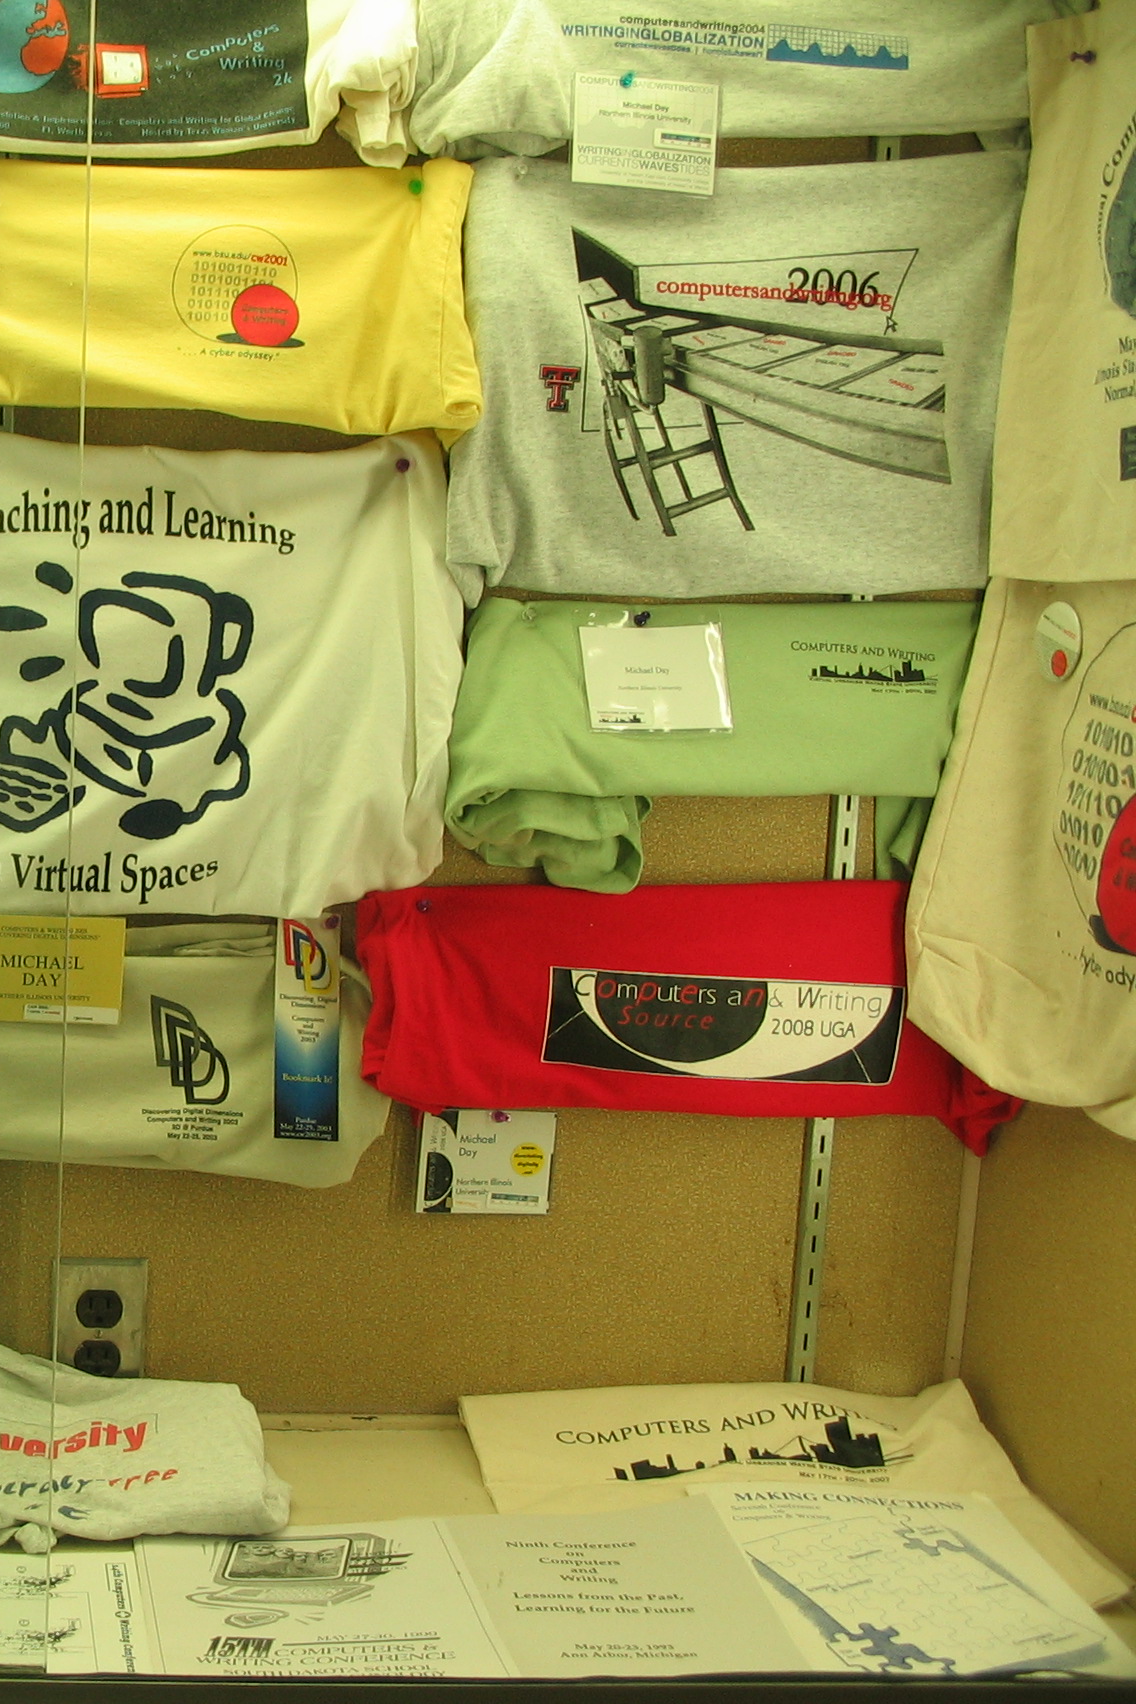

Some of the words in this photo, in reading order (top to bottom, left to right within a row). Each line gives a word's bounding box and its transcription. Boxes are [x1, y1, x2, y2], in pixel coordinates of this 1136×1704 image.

[620, 15, 766, 35] computersandwriting2004
[186, 24, 281, 60] Computers
[561, 24, 764, 49] WRITINGINGLOBALIZATION
[252, 42, 264, 53] &
[220, 55, 285, 70] Writing
[273, 72, 292, 87] 2k
[623, 102, 653, 111] Michael
[655, 103, 669, 113] Day
[785, 266, 881, 309] 2006
[99, 486, 155, 535] and
[164, 489, 297, 556] Learning
[791, 640, 858, 654] COMPUTERS
[861, 646, 885, 657] AND
[887, 648, 936, 662] WRITING
[624, 666, 654, 674] Michael
[655, 667, 670, 675] Day
[11, 852, 112, 894] Virtual
[120, 853, 219, 905] Spaces
[0, 954, 84, 970] MICHAEL
[22, 973, 62, 987] DAY
[279, 993, 314, 1003] Discovering
[317, 995, 338, 1003] Digital
[574, 973, 716, 1007] Computers
[797, 985, 883, 1018] Writing
[291, 1001, 326, 1009] Dimensions
[617, 1006, 715, 1030] Source
[297, 1029, 320, 1037] Writing
[771, 1018, 814, 1038] 2008
[819, 1021, 857, 1039] UGA
[282, 1073, 322, 1083] Bookmark
[205, 1109, 244, 1117] Dimensions
[295, 1116, 317, 1124] Purdue
[280, 1123, 294, 1131] May
[167, 1132, 181, 1140] May
[459, 1133, 497, 1144] Michael
[459, 1147, 478, 1159] Day
[456, 1178, 488, 1186] Northern
[556, 1418, 712, 1445] COMPUTERS
[720, 1409, 776, 1432] AND
[733, 1491, 818, 1501] MAKING
[822, 1493, 965, 1511] CONNECTIONS
[505, 1541, 549, 1549] Ninth
[553, 1540, 637, 1550] Conference
[538, 1557, 621, 1567] Computers
[559, 1574, 618, 1584] Writing
[513, 1591, 574, 1600] Lessons
[578, 1592, 615, 1601] from
[619, 1593, 643, 1601] the
[647, 1593, 685, 1601] Past,
[514, 1604, 586, 1614] Learning
[589, 1605, 610, 1613] for
[615, 1606, 639, 1614] the
[643, 1605, 695, 1614] Future
[119, 1621, 129, 1643] Writing
[204, 1637, 276, 1659] 15TH
[274, 1644, 415, 1657] COMPUTERS
[574, 1643, 604, 1651] May
[195, 1656, 291, 1666] WRITING
[300, 1651, 456, 1666] CONFERENCE
[592, 1651, 633, 1659] Arbor,
[636, 1651, 698, 1659] Michigan
[287, 1667, 358, 1676] DAKOTA
[363, 1664, 437, 1673] SCHOOL
